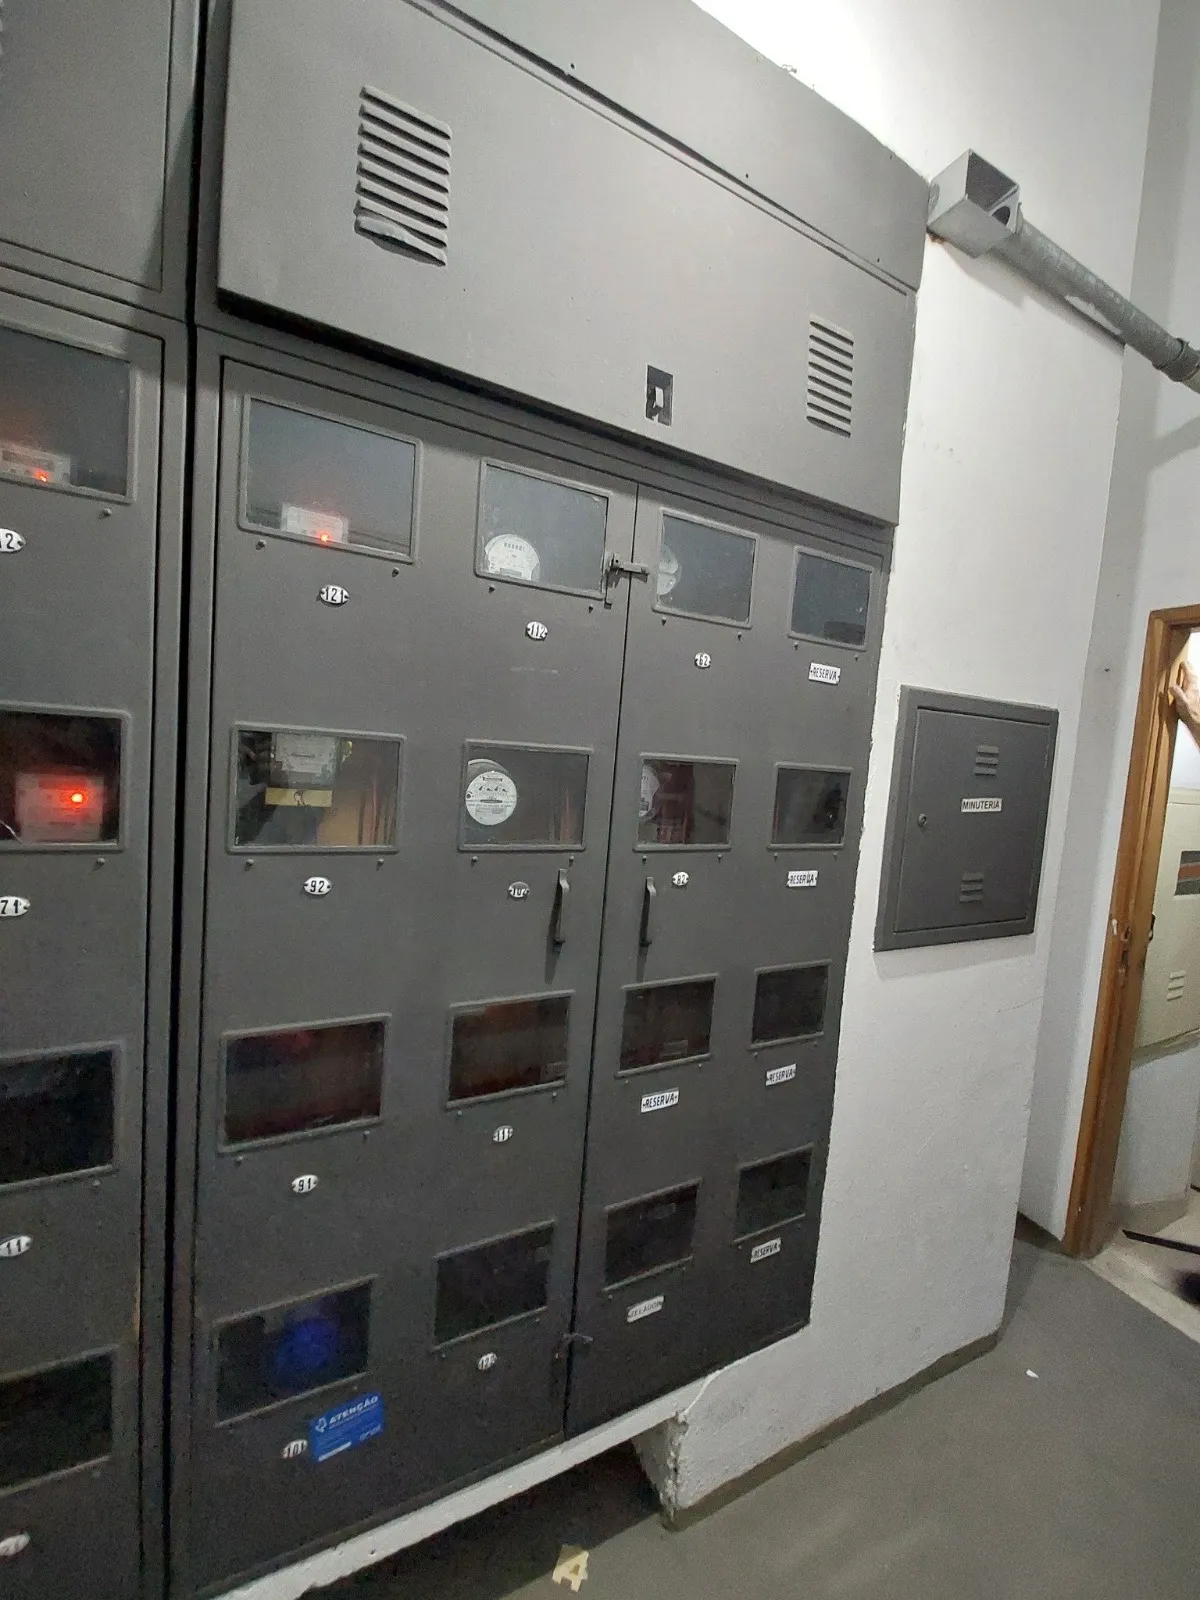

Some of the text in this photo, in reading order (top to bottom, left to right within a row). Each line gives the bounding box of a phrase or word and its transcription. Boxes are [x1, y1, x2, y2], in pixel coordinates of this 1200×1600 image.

[0, 533, 15, 550] 2
[325, 586, 344, 604] 121
[531, 623, 546, 640] 112
[812, 666, 838, 682] RESERVA
[963, 800, 1000, 810] MINUTERIA
[310, 880, 325, 893] 92
[790, 873, 815, 884] RESERVA
[1, 899, 19, 915] 71
[769, 1068, 793, 1082] RESERVA
[645, 1092, 675, 1109] RESERVA
[298, 1178, 312, 1191] 91
[754, 1240, 778, 1259] RESERVA
